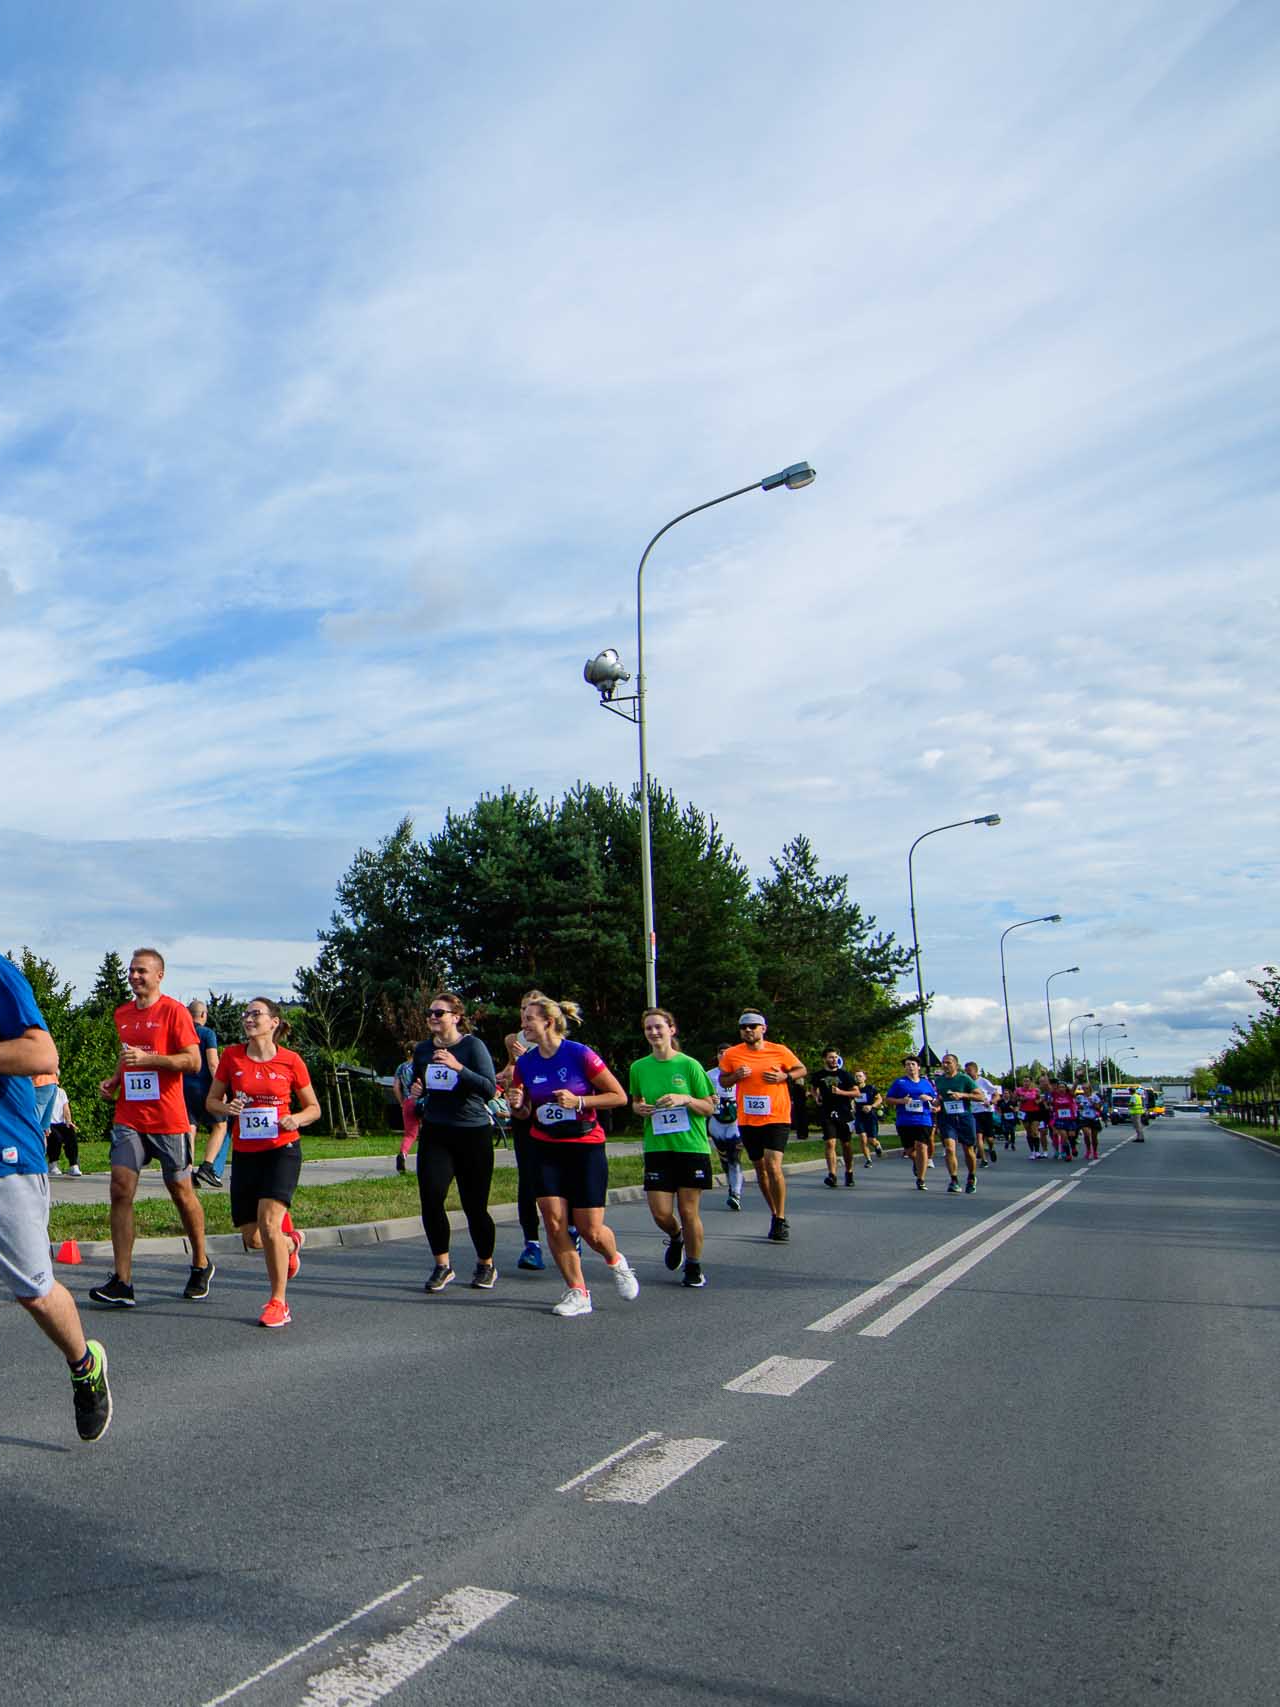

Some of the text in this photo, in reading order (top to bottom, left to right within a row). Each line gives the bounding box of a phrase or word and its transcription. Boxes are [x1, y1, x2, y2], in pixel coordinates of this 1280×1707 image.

[434, 1070, 449, 1081] 34
[130, 1078, 152, 1090] 118
[748, 1100, 765, 1109] 123
[545, 1108, 563, 1120] 26
[662, 1113, 678, 1124] 12
[246, 1115, 269, 1128] 134
